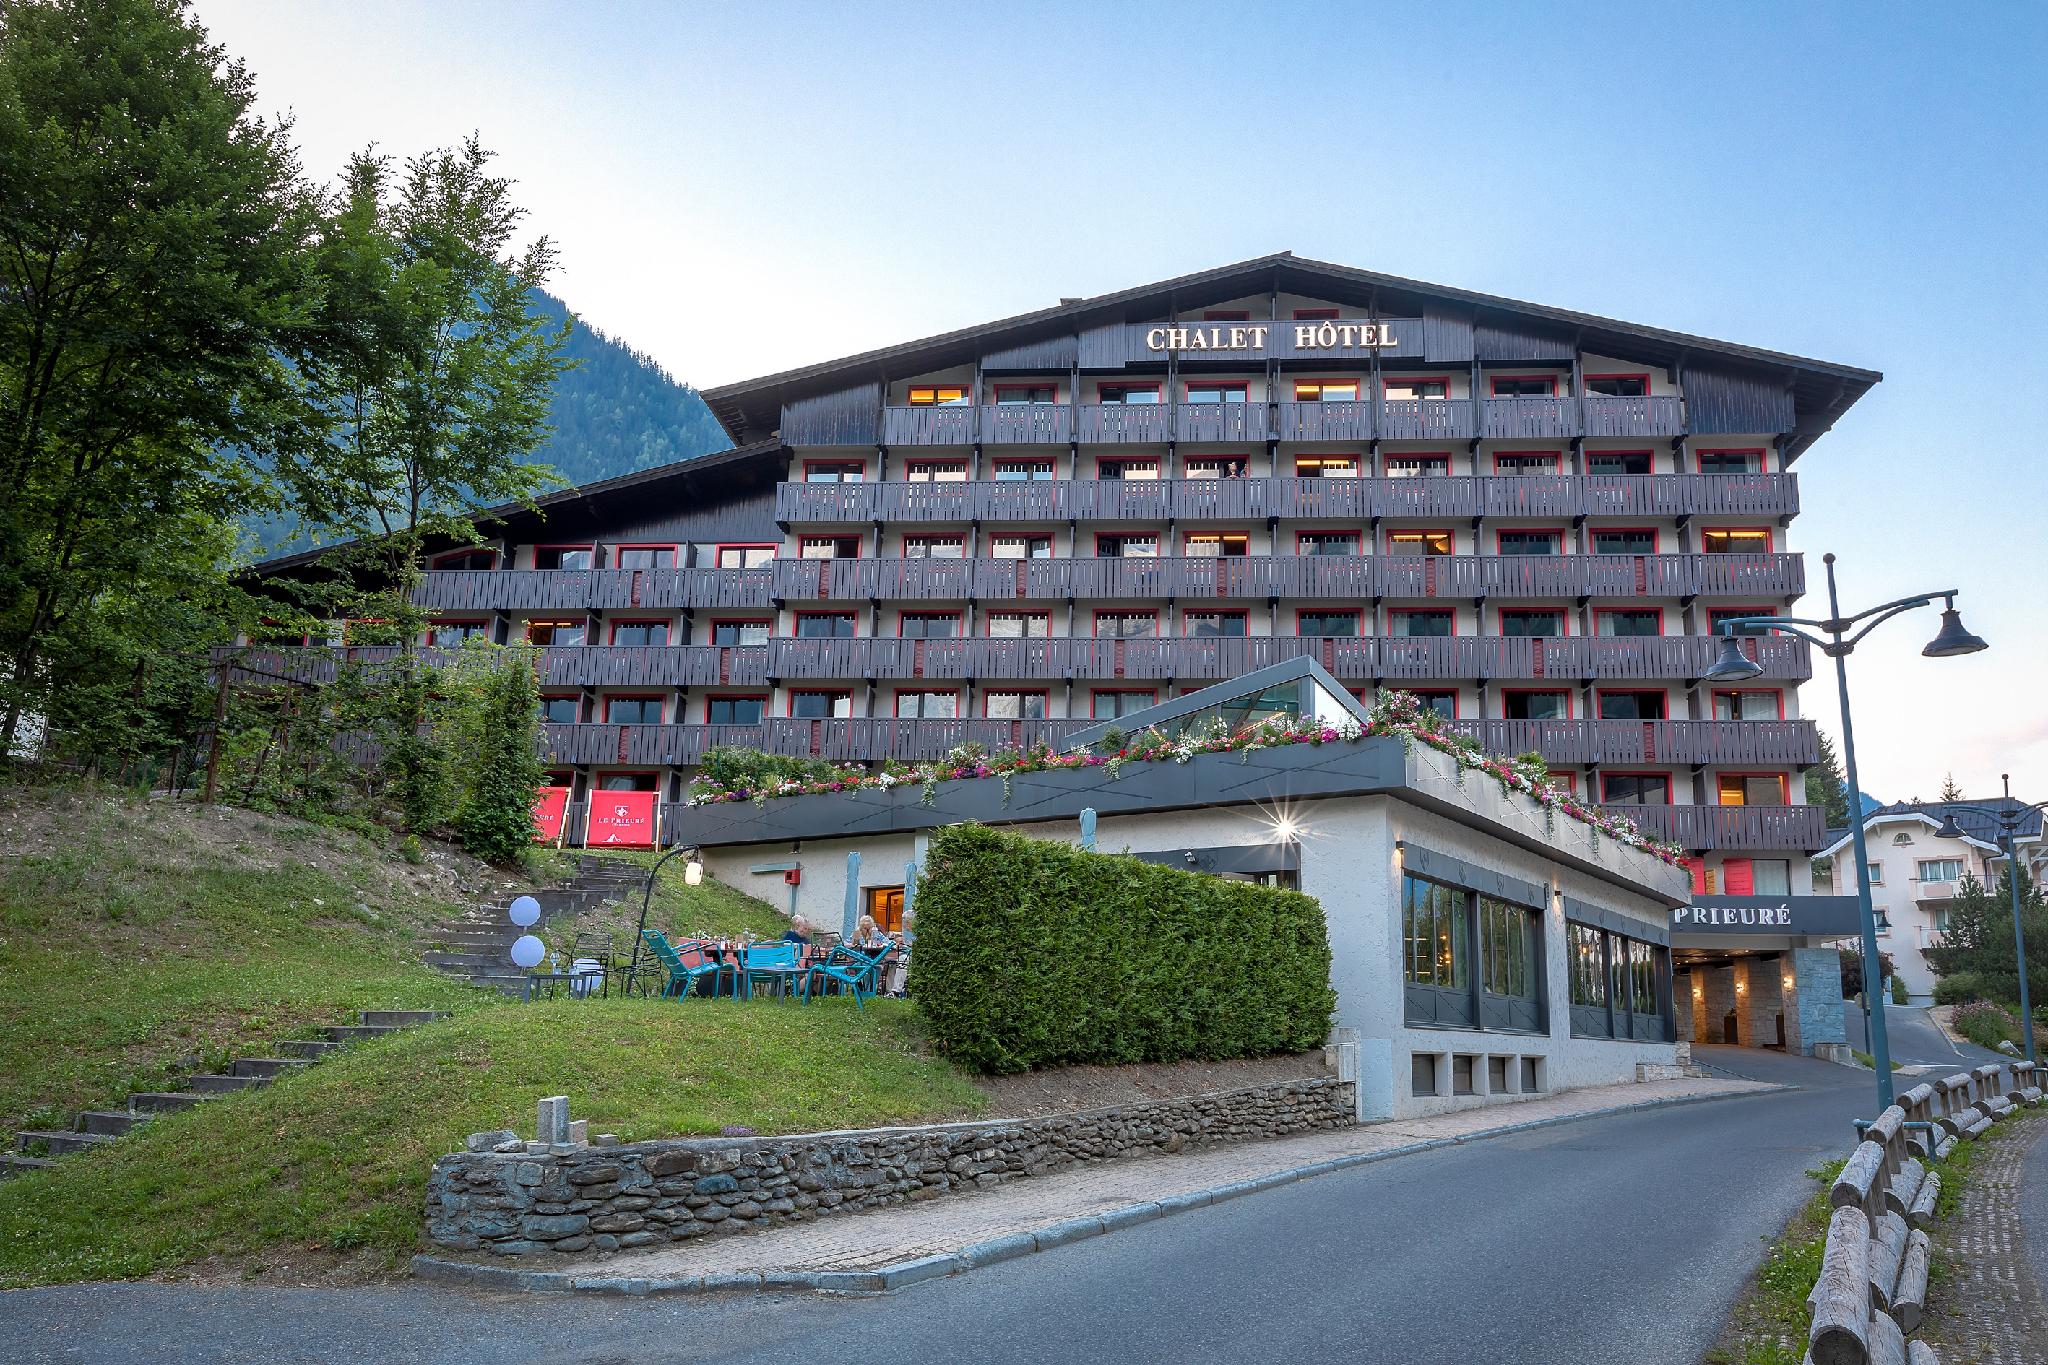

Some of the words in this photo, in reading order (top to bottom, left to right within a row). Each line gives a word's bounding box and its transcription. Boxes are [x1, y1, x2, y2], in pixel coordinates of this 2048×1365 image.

[1146, 326, 1268, 351] CHALET
[1294, 320, 1398, 349] HÔTEL
[1674, 903, 1792, 925] PRIEURÉ
